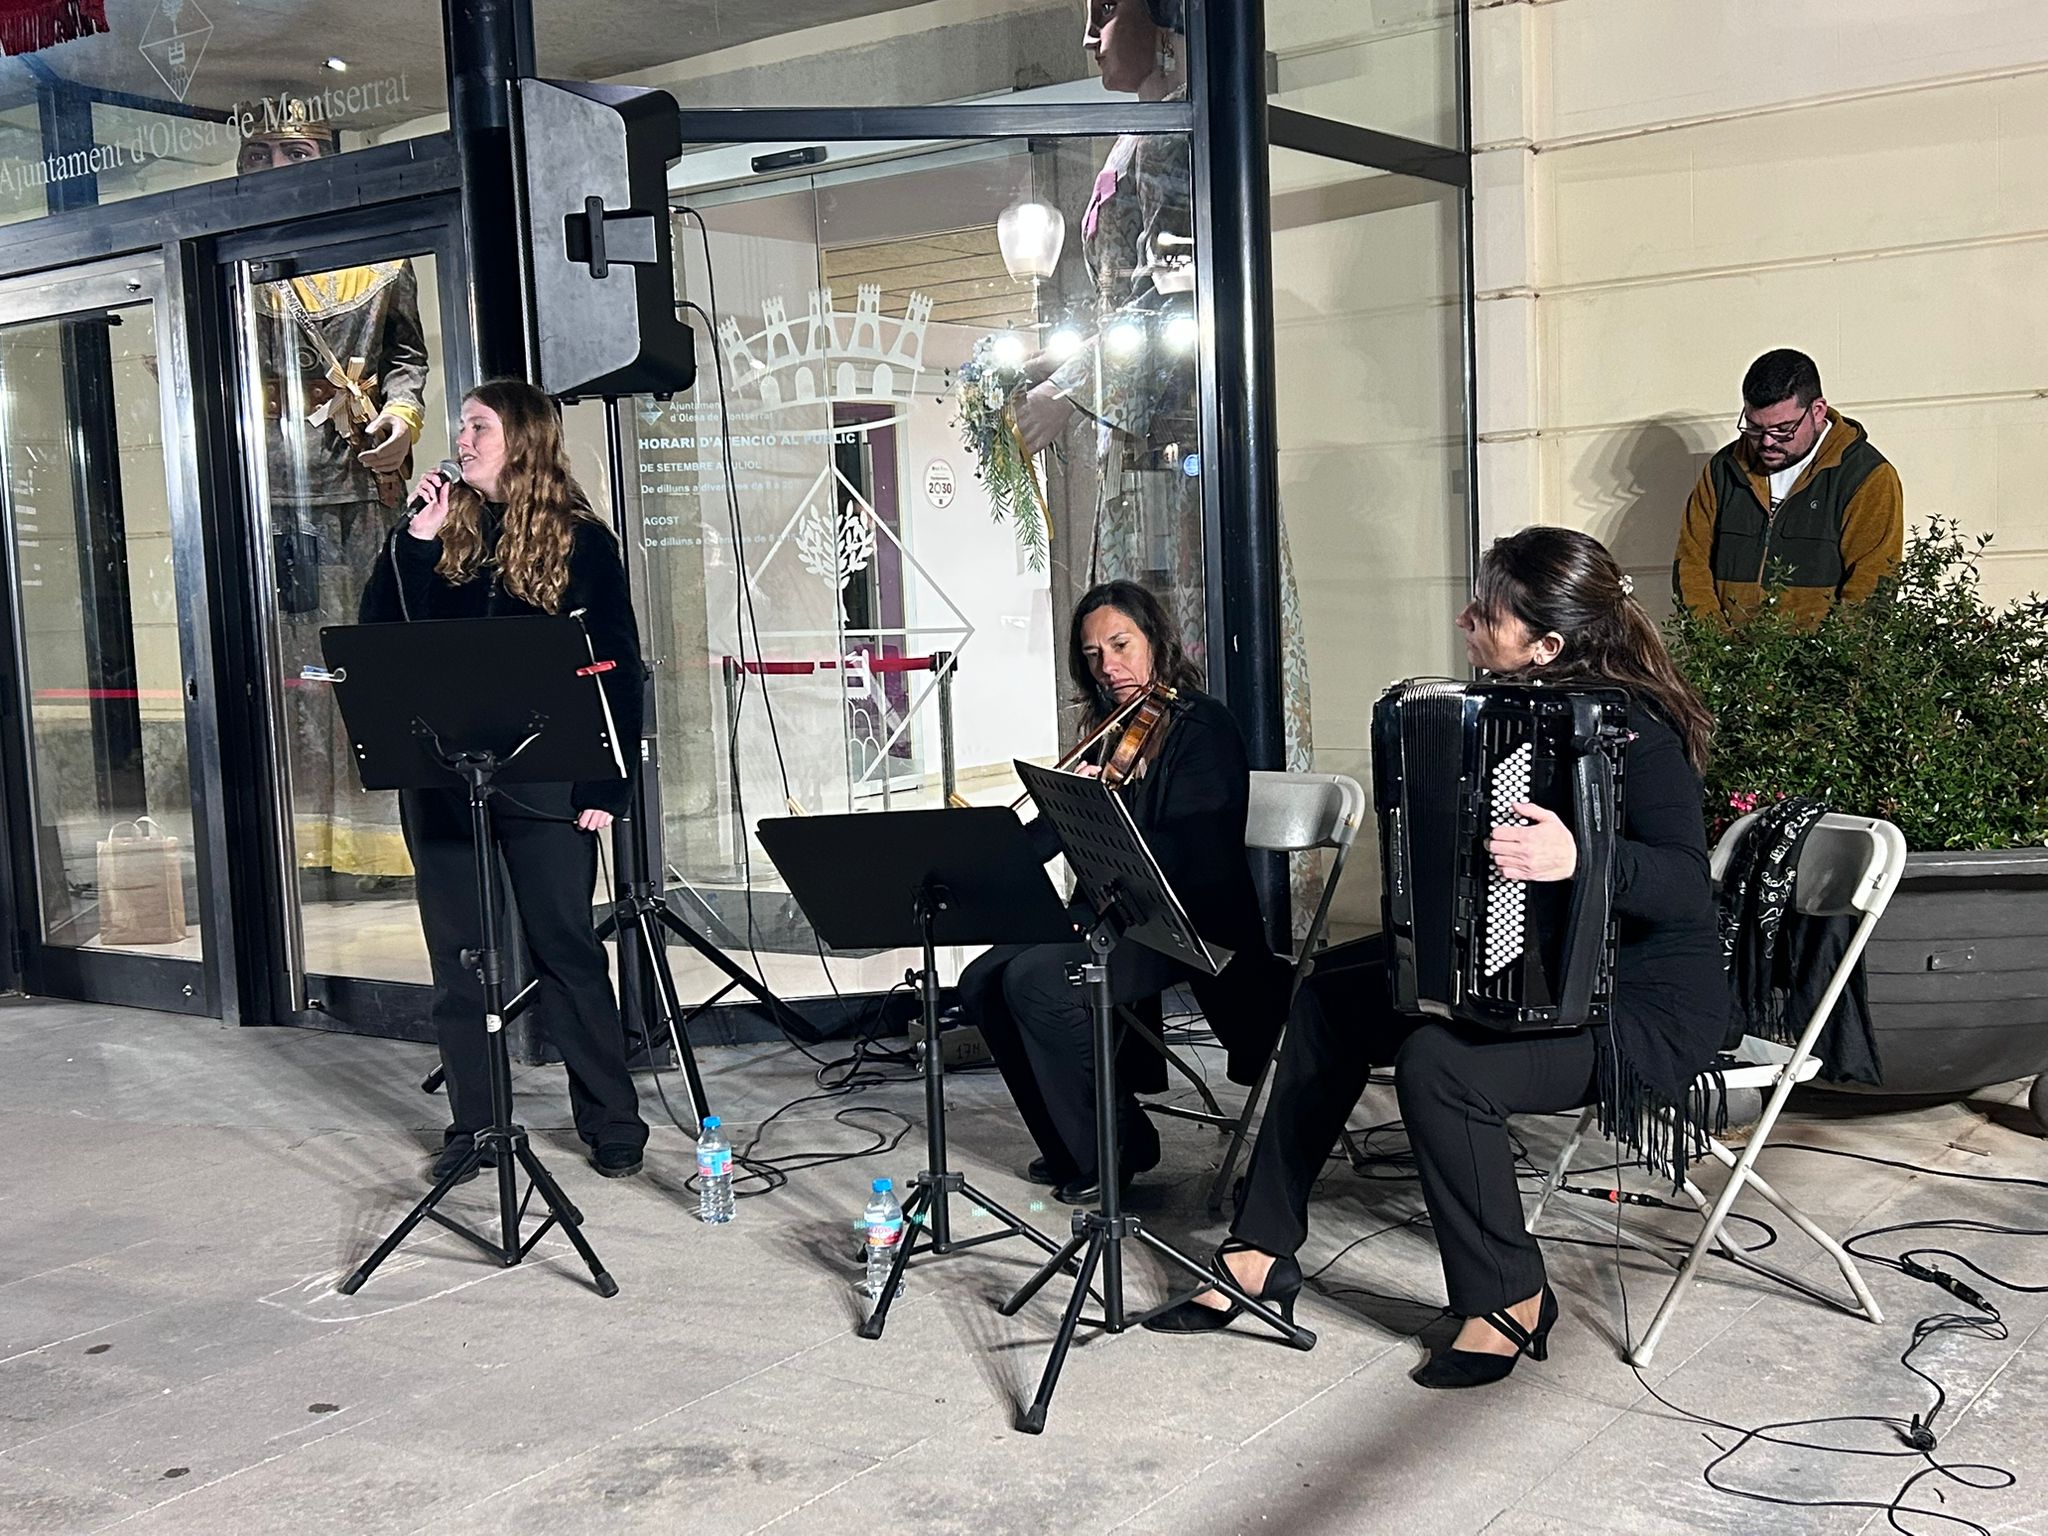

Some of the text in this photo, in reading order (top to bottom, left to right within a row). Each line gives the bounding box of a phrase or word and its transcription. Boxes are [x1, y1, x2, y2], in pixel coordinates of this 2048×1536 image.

[0, 71, 411, 199] Ajuntament d'Olesa de Montserrat
[669, 401, 723, 412] Ajuntamen
[721, 410, 774, 422] ontserrat
[639, 437, 695, 449] HORARI
[700, 433, 776, 449] D'AENCIÓ
[781, 434, 800, 446] AL
[639, 463, 655, 473] DE
[657, 461, 715, 472] SETEMBRE
[727, 460, 763, 470] ULIOL
[641, 485, 654, 494] De
[657, 483, 690, 494] dilluns
[929, 482, 952, 494] 2030
[643, 515, 680, 526] AGOST
[645, 538, 658, 547] De
[660, 536, 694, 547] dilluns
